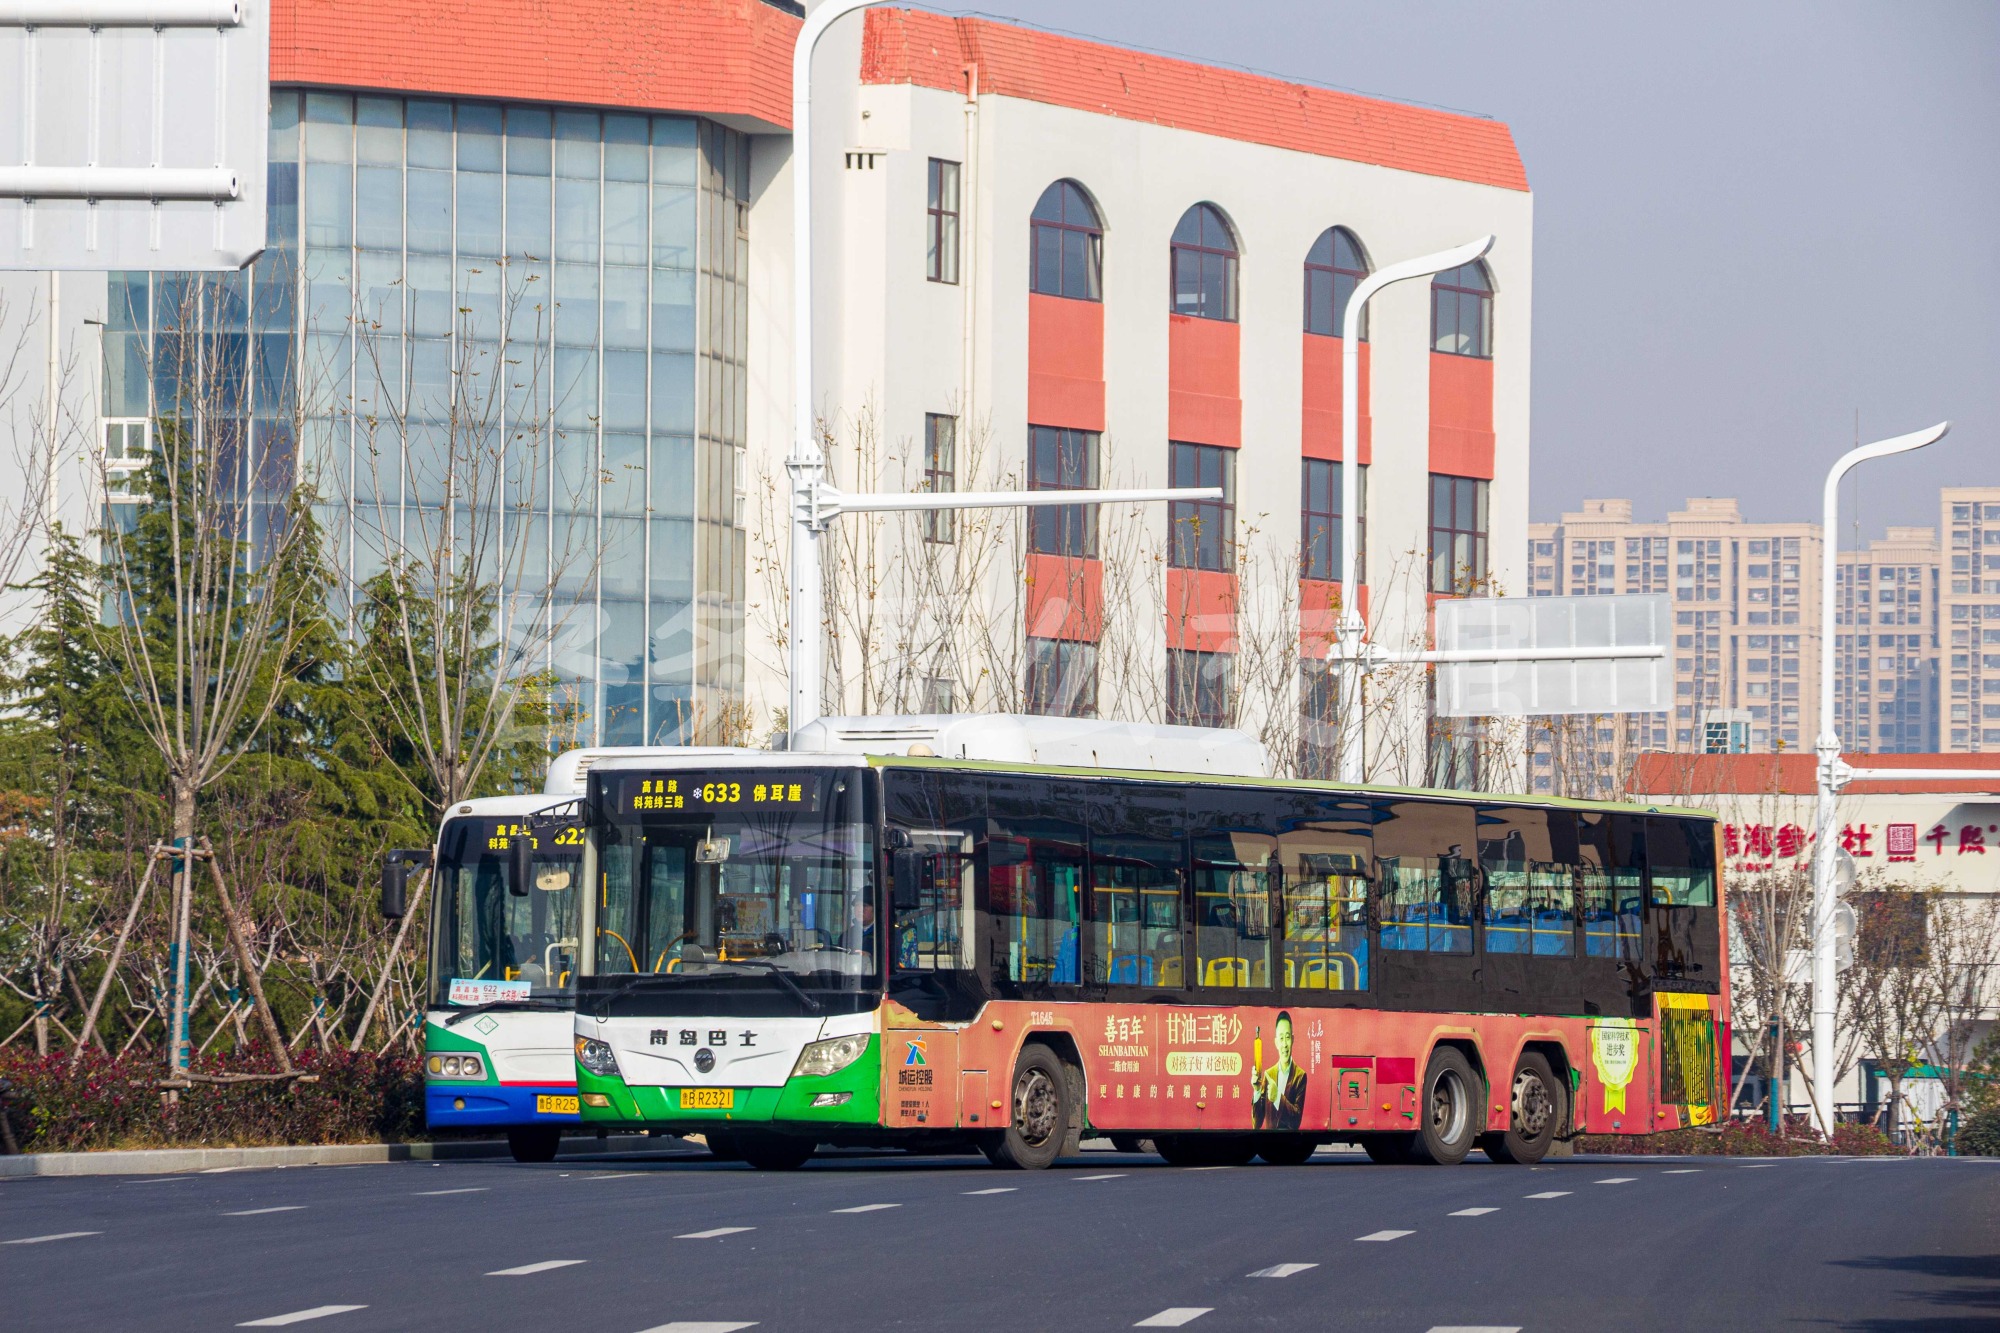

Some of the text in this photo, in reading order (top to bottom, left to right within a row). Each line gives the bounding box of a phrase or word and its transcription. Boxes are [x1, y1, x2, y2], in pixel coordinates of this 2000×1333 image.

[642, 780, 678, 793] 高昌路
[703, 783, 741, 803] 633
[753, 784, 802, 802] 佛耳崖
[633, 796, 684, 809] 科苑纬三路
[1031, 1011, 1053, 1025] T1645
[1104, 1015, 1144, 1044] 善百年
[1166, 1012, 1243, 1045] 甘油三酯少
[649, 1029, 758, 1047] 青岛巴士
[1099, 1044, 1149, 1056] SHANBAINIAN
[1606, 1043, 1625, 1056] 进步奖
[1108, 1061, 1140, 1072] 二酯食用油
[1172, 1056, 1237, 1072] 对孩子好 对爸妈好
[898, 1069, 933, 1086] 城运控股
[1100, 1084, 1240, 1099] 更健康的高端食用油
